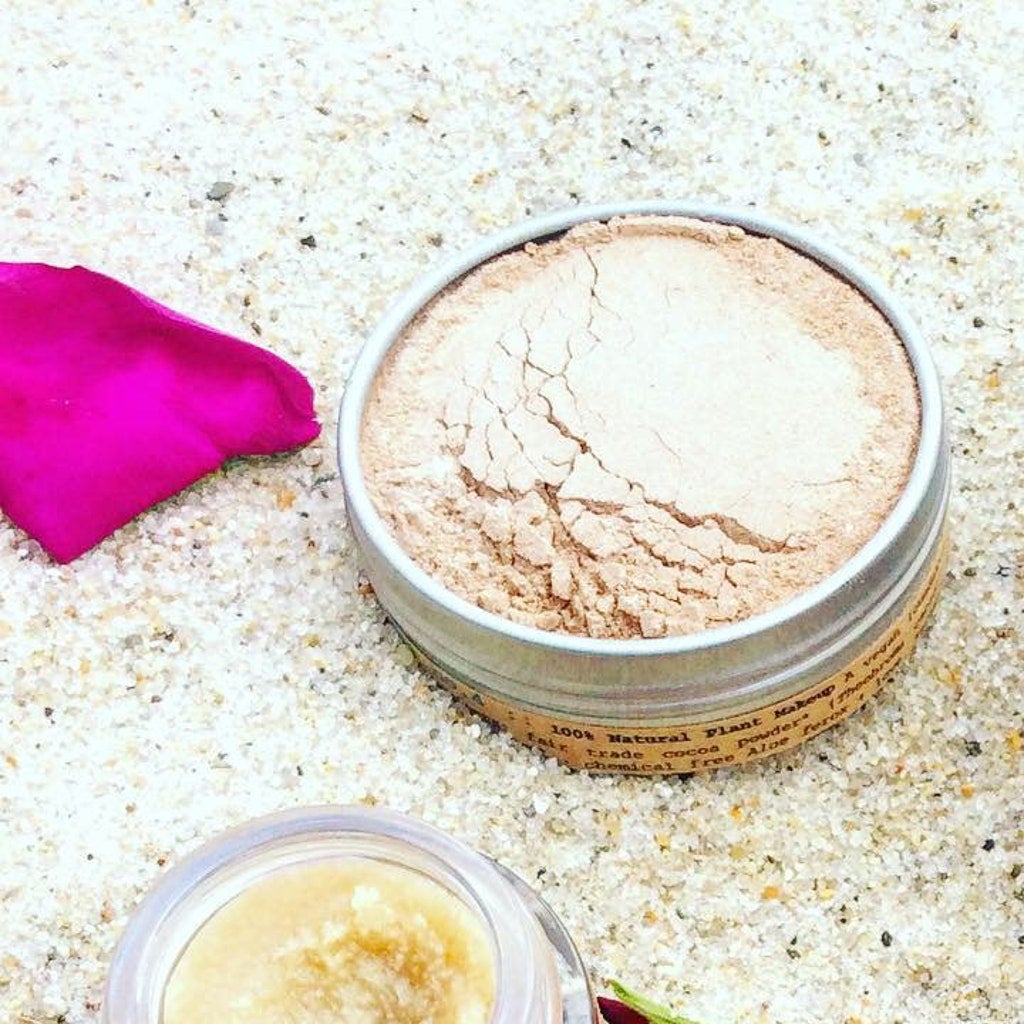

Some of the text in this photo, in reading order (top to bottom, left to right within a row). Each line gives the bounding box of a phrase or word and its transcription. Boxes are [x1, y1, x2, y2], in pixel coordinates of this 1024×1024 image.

[550, 724, 596, 742] 100%
[606, 732, 692, 744] Natural
[705, 717, 763, 739] Plant
[773, 683, 837, 719] Makeup
[585, 748, 644, 760] trade
[661, 744, 720, 759] cocoa
[690, 753, 736, 769] free
[747, 736, 790, 757] Aloe
